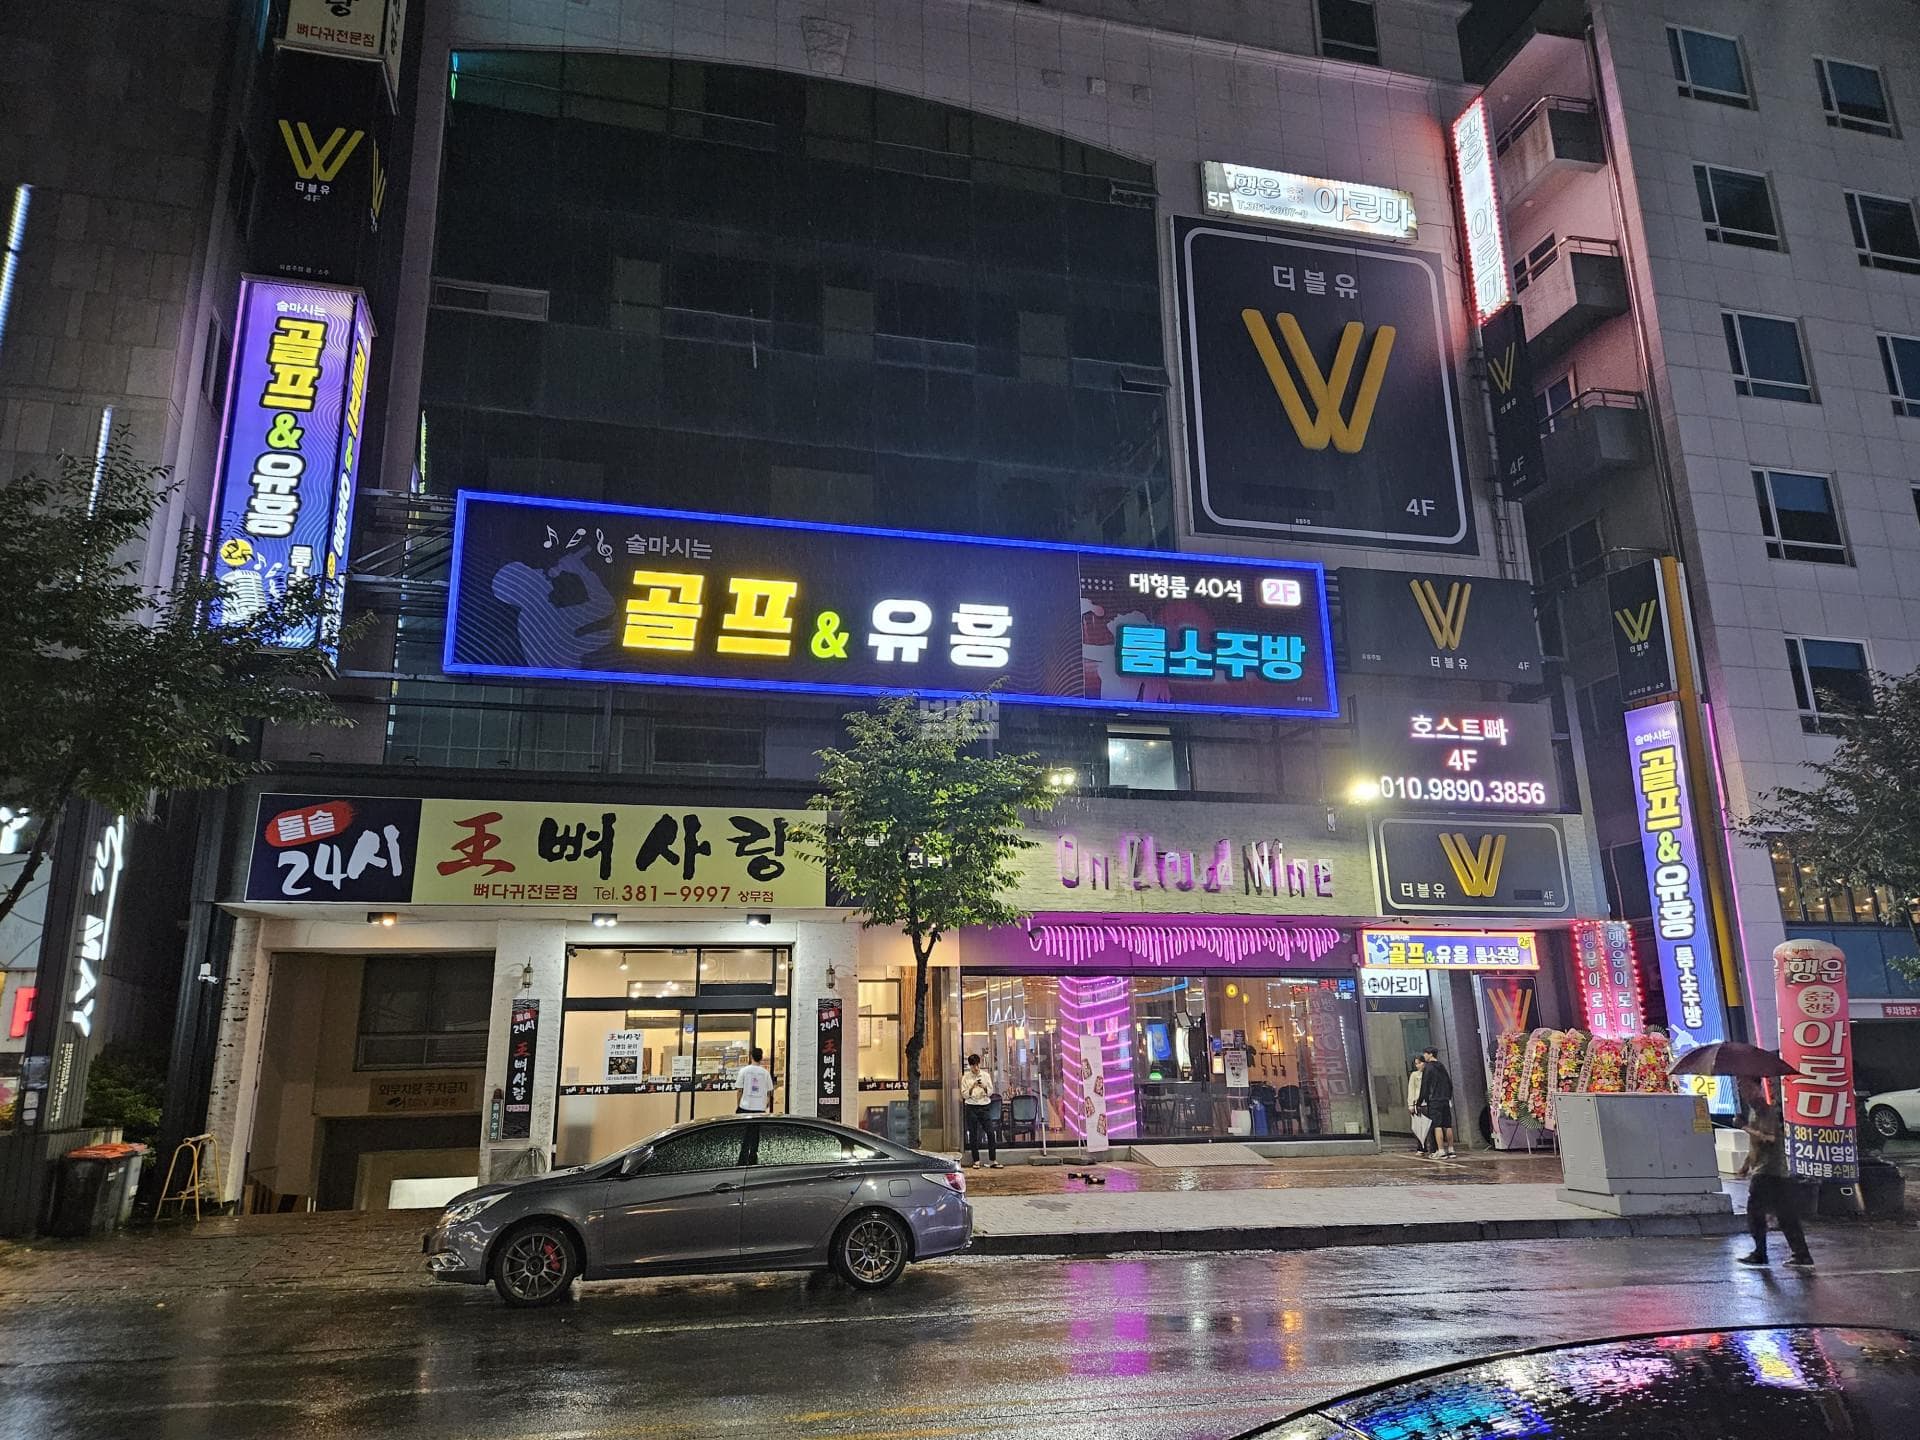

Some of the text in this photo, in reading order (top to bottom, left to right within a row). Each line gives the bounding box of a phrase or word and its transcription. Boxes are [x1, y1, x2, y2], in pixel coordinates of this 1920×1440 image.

[296, 23, 375, 48] 뼈다귀전문점
[295, 181, 330, 195] 더블유
[1235, 173, 1281, 199] 행운
[1207, 192, 1230, 207] 5F
[1314, 187, 1411, 231] 아로마
[1470, 198, 1505, 306] 아로마
[1272, 265, 1358, 299] 더블유
[276, 300, 327, 317] 술마시는
[262, 318, 326, 411] 골프
[266, 412, 303, 449] &
[1510, 455, 1525, 475] 4F
[245, 453, 306, 537] 유흥
[1405, 498, 1435, 517] 4F
[626, 533, 713, 560] 술마시는
[1129, 573, 1242, 602] 대형룸 40석
[1266, 581, 1296, 603] 2F
[622, 570, 1013, 668] 골프 & 유흥
[1120, 625, 1306, 681] 룸소주방
[1431, 656, 1469, 670] 더블유
[1518, 661, 1530, 671] 4F
[1411, 714, 1509, 746] 호스트빠
[1635, 729, 1672, 745] 술마시는
[1448, 749, 1478, 771] 4F
[1380, 776, 1546, 805] 010.9890.3856
[277, 810, 336, 842] 돌솥
[537, 812, 794, 881] 뼈사랑
[1641, 746, 1695, 939] 골프 & 유흥
[277, 824, 402, 896] 24시
[473, 884, 579, 901] 뼈다귀전문점
[738, 891, 774, 904] 상무점
[1401, 882, 1447, 899] 더블유
[1543, 890, 1554, 899] 4F
[1519, 936, 1531, 947] 2F
[1389, 943, 1425, 964] 골프
[1426, 950, 1436, 963] &
[1475, 946, 1520, 964] 룸소주방
[72, 914, 105, 1038] MAY
[1789, 958, 1844, 983] 행운
[1381, 975, 1423, 995] 아로마
[1675, 946, 1703, 1028] 룸소주방
[1804, 991, 1835, 1003] 중국
[1804, 1003, 1835, 1014] 전통
[513, 1020, 536, 1034] 24시
[820, 1018, 840, 1031] 24시
[1791, 1020, 1851, 1127] 아로마
[378, 1081, 468, 1096] 외부차량 주차금지
[1694, 1076, 1716, 1095] 2F
[1794, 1142, 1856, 1162] 24시영업
